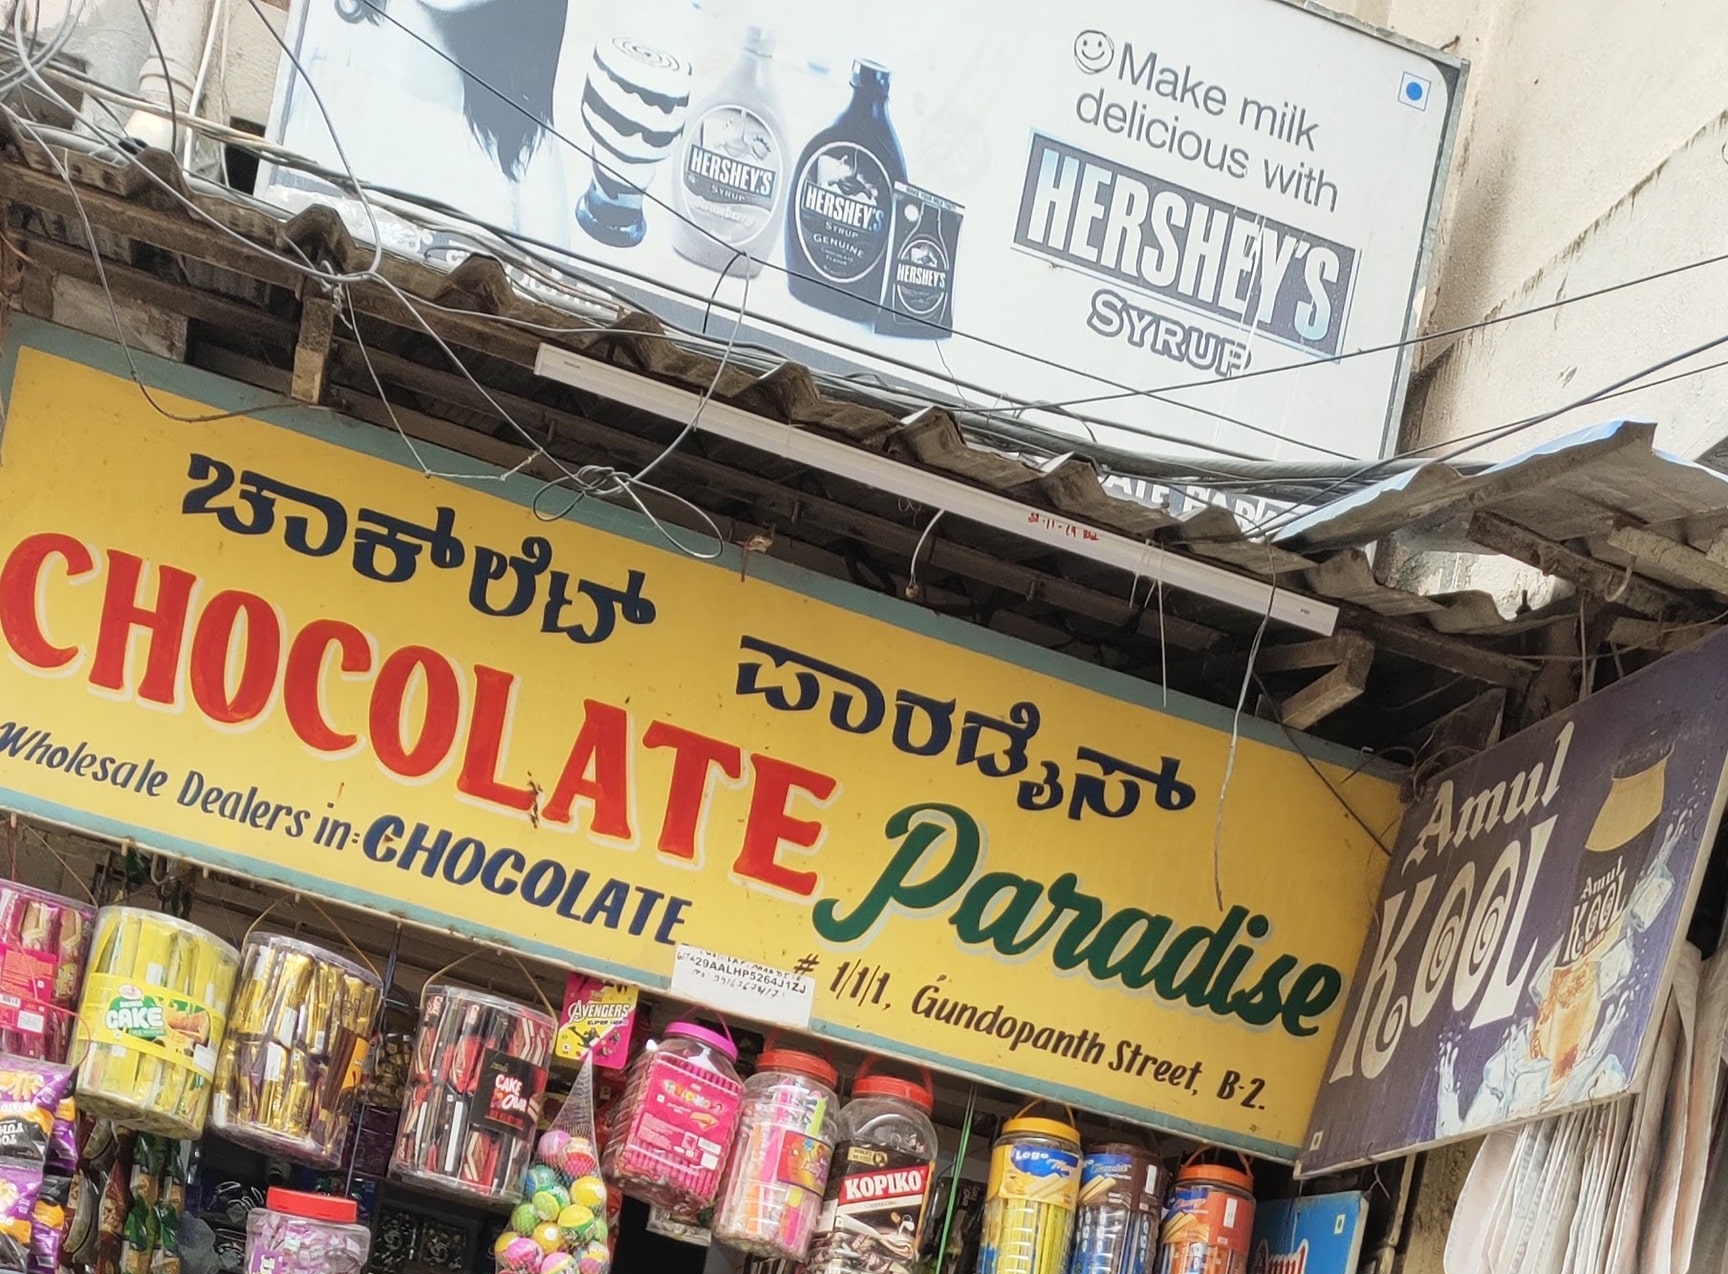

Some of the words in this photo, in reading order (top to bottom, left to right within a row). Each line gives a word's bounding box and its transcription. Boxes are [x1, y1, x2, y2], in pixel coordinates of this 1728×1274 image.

[1118, 42, 1227, 117] Make
[1240, 96, 1319, 153] milk
[689, 147, 773, 196] HERSHEY'S
[1075, 88, 1249, 179] delicious
[1263, 158, 1340, 213] with
[804, 185, 884, 232] HERSHEY'S
[813, 232, 866, 259] GENUINE
[1025, 148, 1340, 341] HERSHEY'S
[896, 263, 947, 289] HERSHEY'S
[1087, 289, 1253, 378] SYRUP
[0, 531, 838, 898] CHOCOLATE
[1402, 720, 1576, 877] Amul
[0, 720, 169, 797] Wholesale
[178, 770, 312, 838] Dealers
[362, 815, 693, 946] CHOCOLATE
[1580, 854, 1626, 898] Amul
[811, 802, 1343, 1036] Paradise
[1562, 871, 1628, 968] KOOL
[1329, 814, 1560, 1085] KOOL
[105, 1007, 164, 1030] CAKE
[567, 999, 630, 1024] AVENGERS
[495, 1074, 523, 1092] CAKE
[1108, 1038, 1200, 1098] Street,
[844, 1170, 922, 1200] KOPIKO
[1014, 1149, 1049, 1162] Logo
